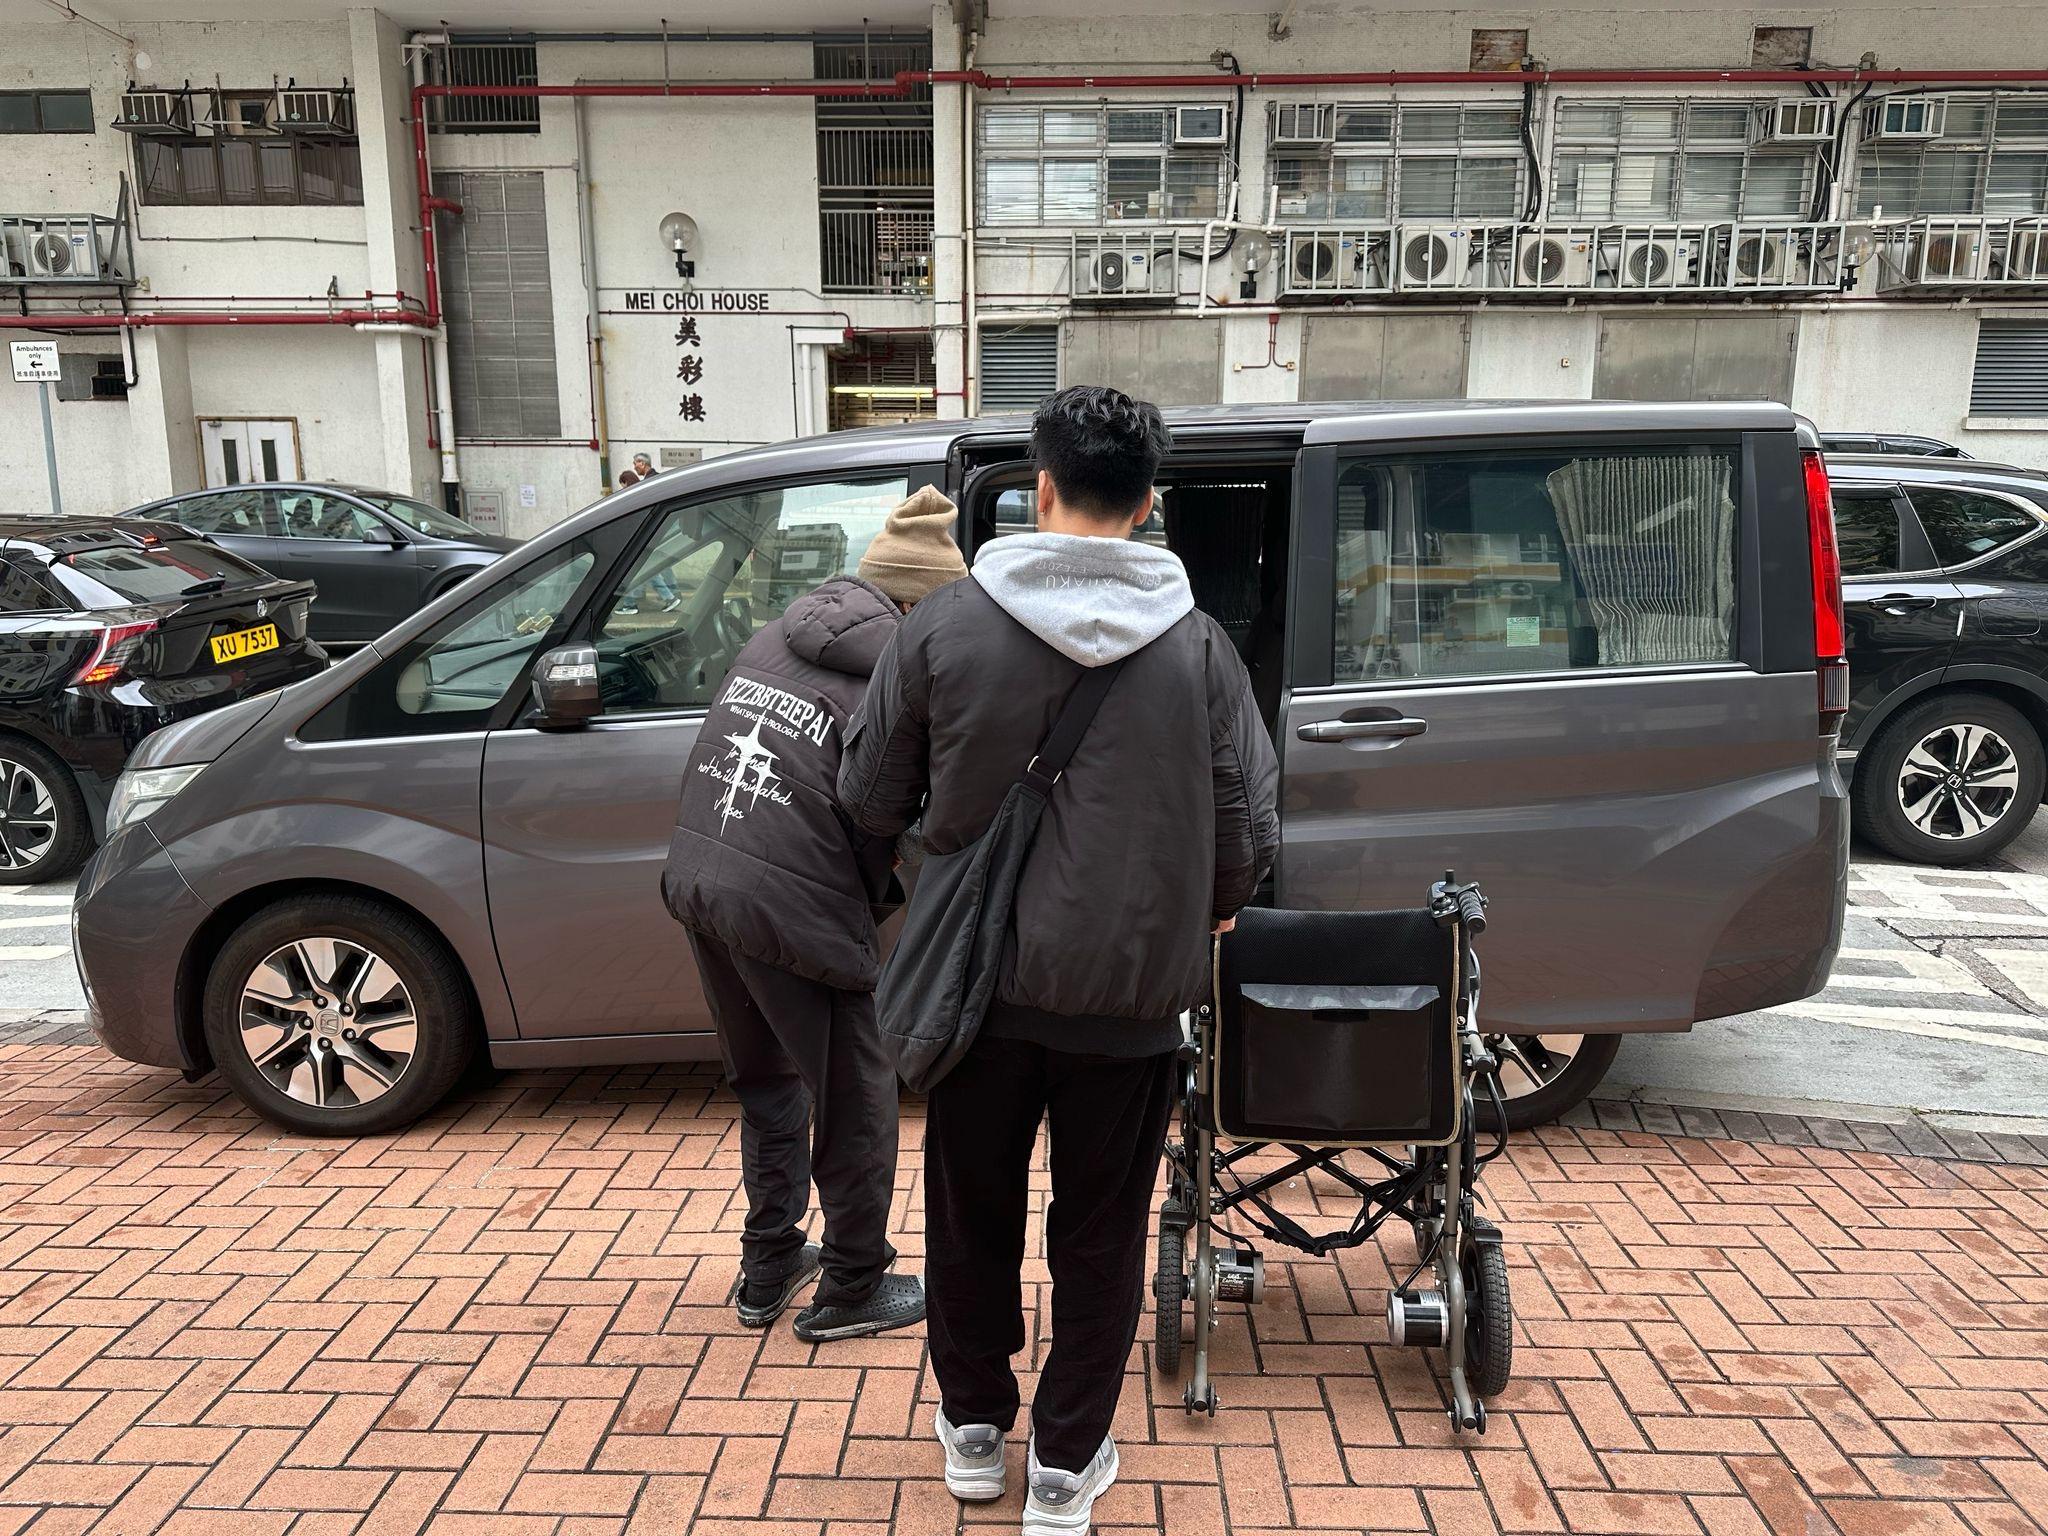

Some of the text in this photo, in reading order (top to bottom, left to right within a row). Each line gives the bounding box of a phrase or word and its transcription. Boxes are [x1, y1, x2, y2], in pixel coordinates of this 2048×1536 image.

[625, 292, 769, 310] MEI CHOI HOUSE
[674, 316, 706, 422] 美彩樓
[216, 627, 272, 659] XU 7537
[766, 718, 801, 740] PROLOGUE
